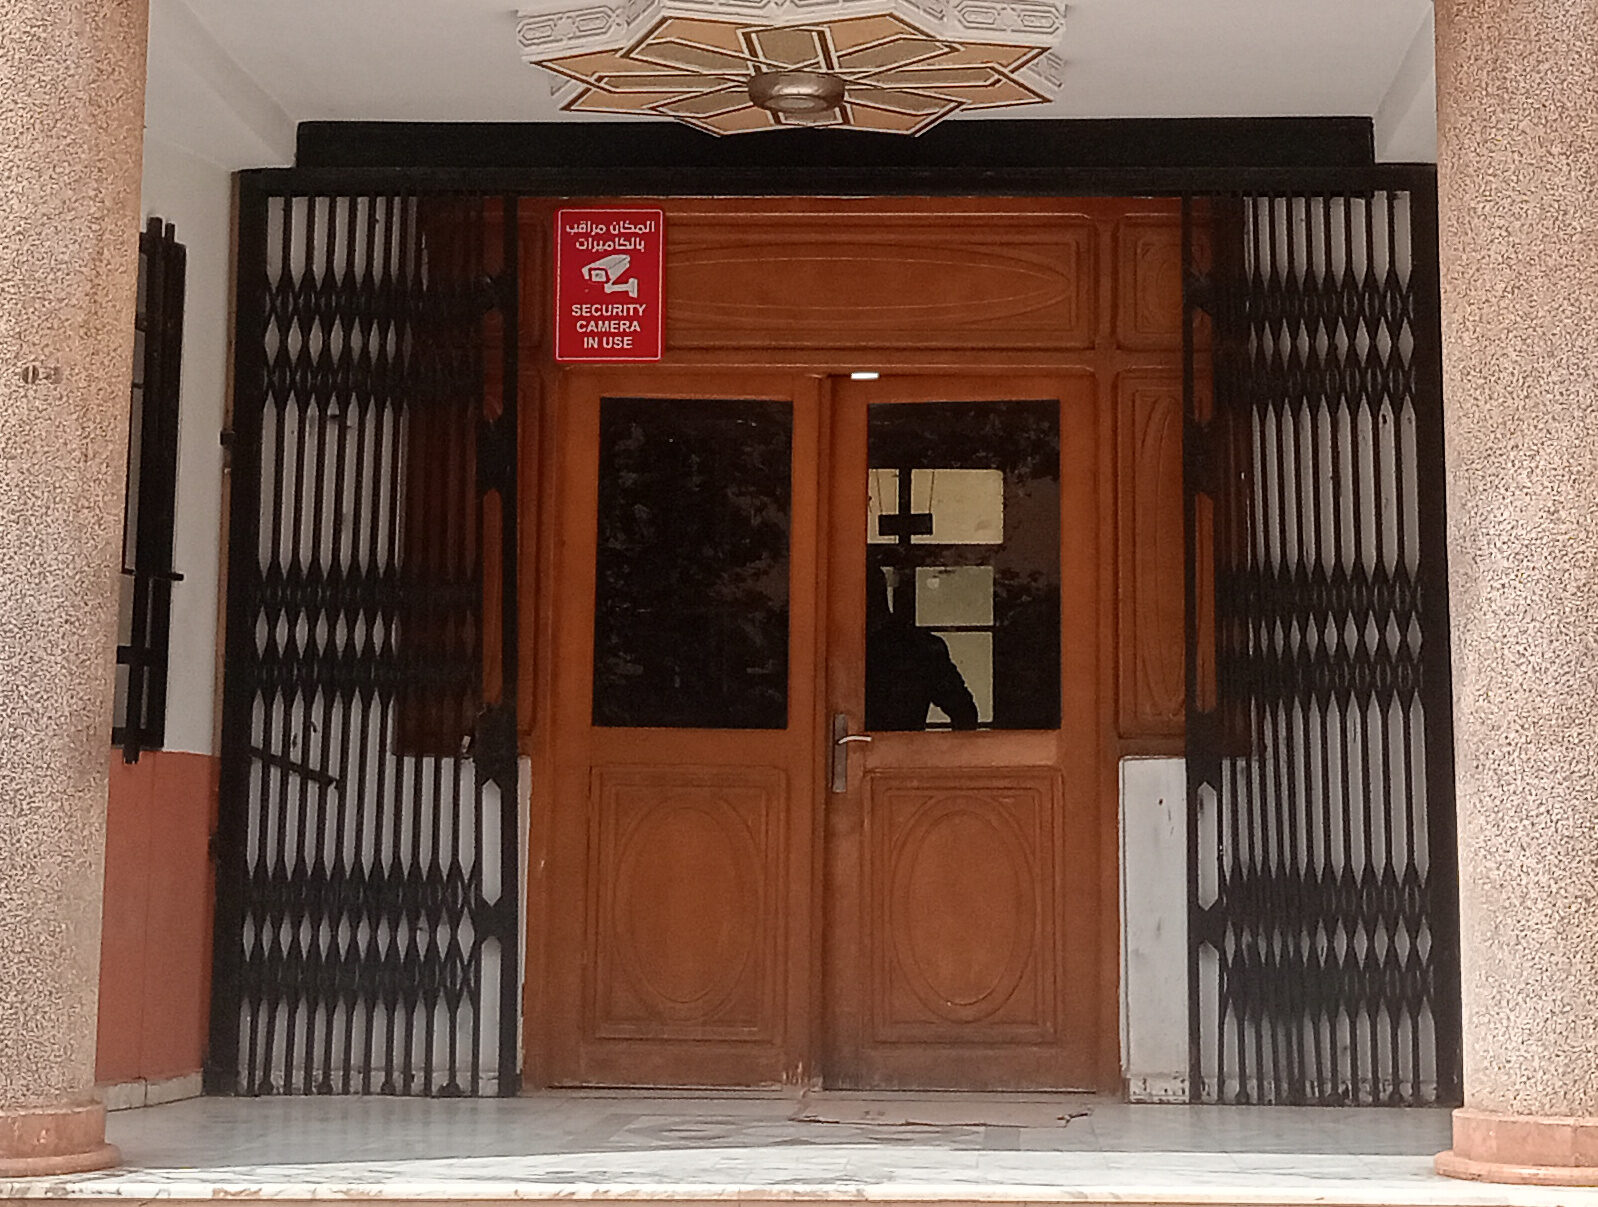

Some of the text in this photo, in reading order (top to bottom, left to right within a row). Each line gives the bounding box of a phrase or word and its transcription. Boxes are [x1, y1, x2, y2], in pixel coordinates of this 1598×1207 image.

[566, 220, 656, 236] المكان مراقب
[576, 237, 645, 253] بالكاميرات
[571, 304, 646, 317] SECURITY
[576, 320, 641, 333] CAMERA
[584, 337, 633, 349] IN USE
